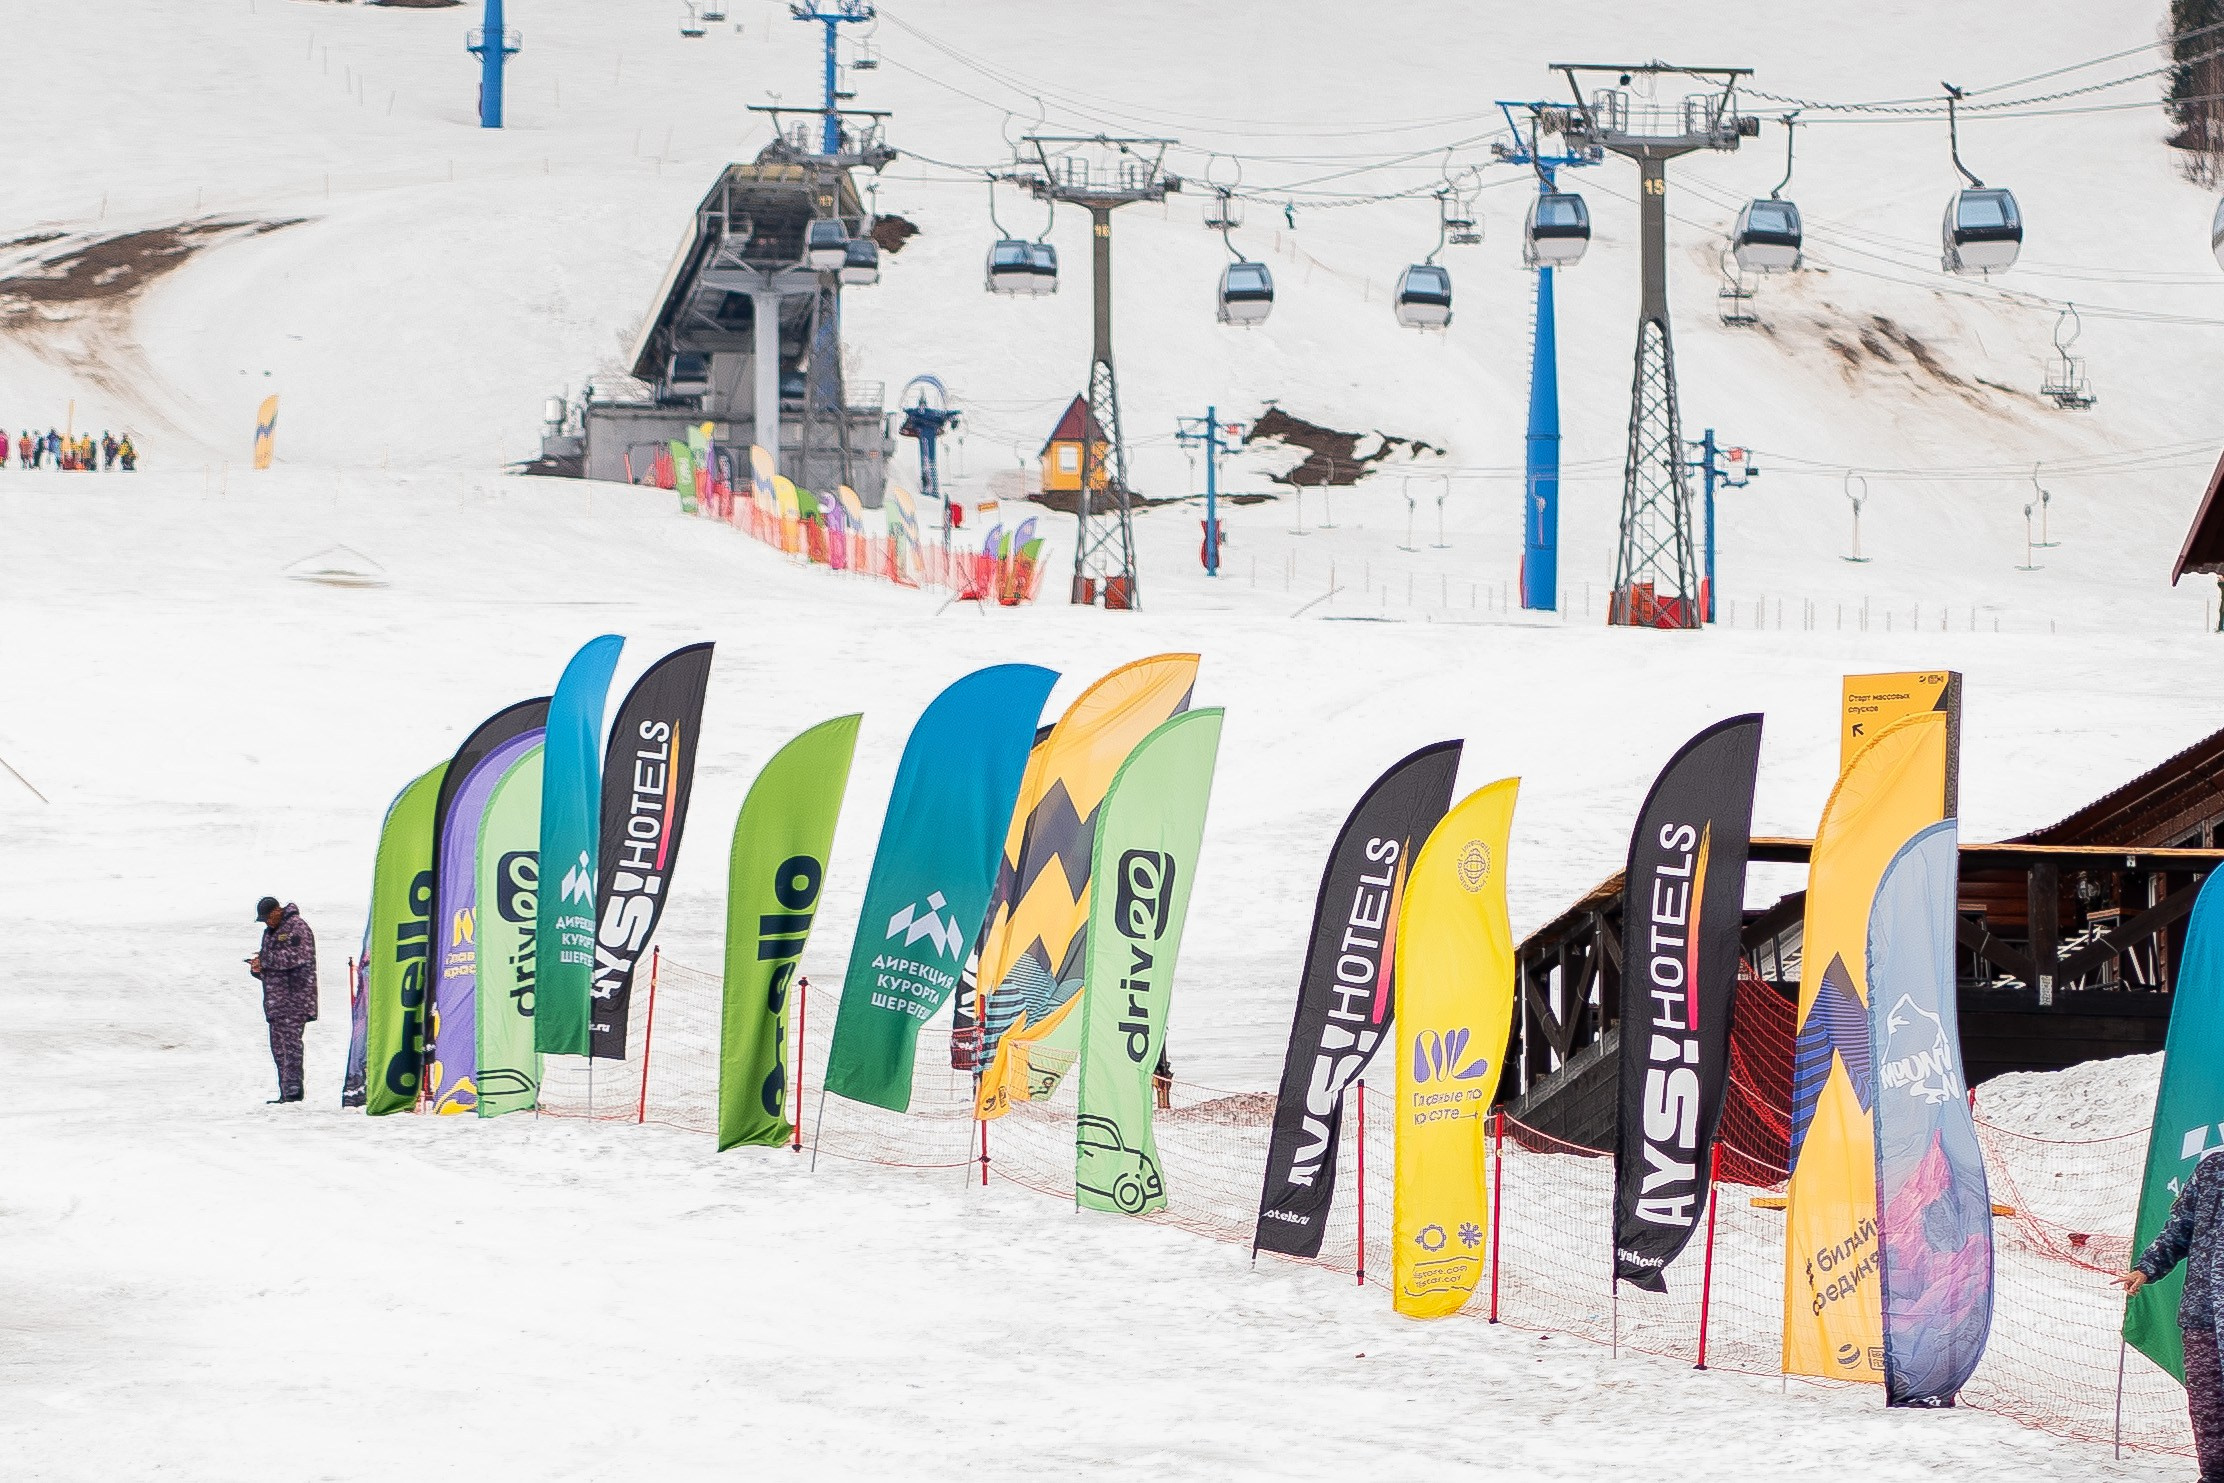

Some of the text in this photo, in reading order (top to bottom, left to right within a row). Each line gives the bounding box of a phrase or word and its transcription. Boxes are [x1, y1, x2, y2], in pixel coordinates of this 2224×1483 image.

[1645, 179, 1665, 195] 15
[871, 953, 955, 989] ДИРЕКЦИЯ
[1116, 850, 1172, 1064] drivee
[877, 973, 940, 1005] КУРОРТА
